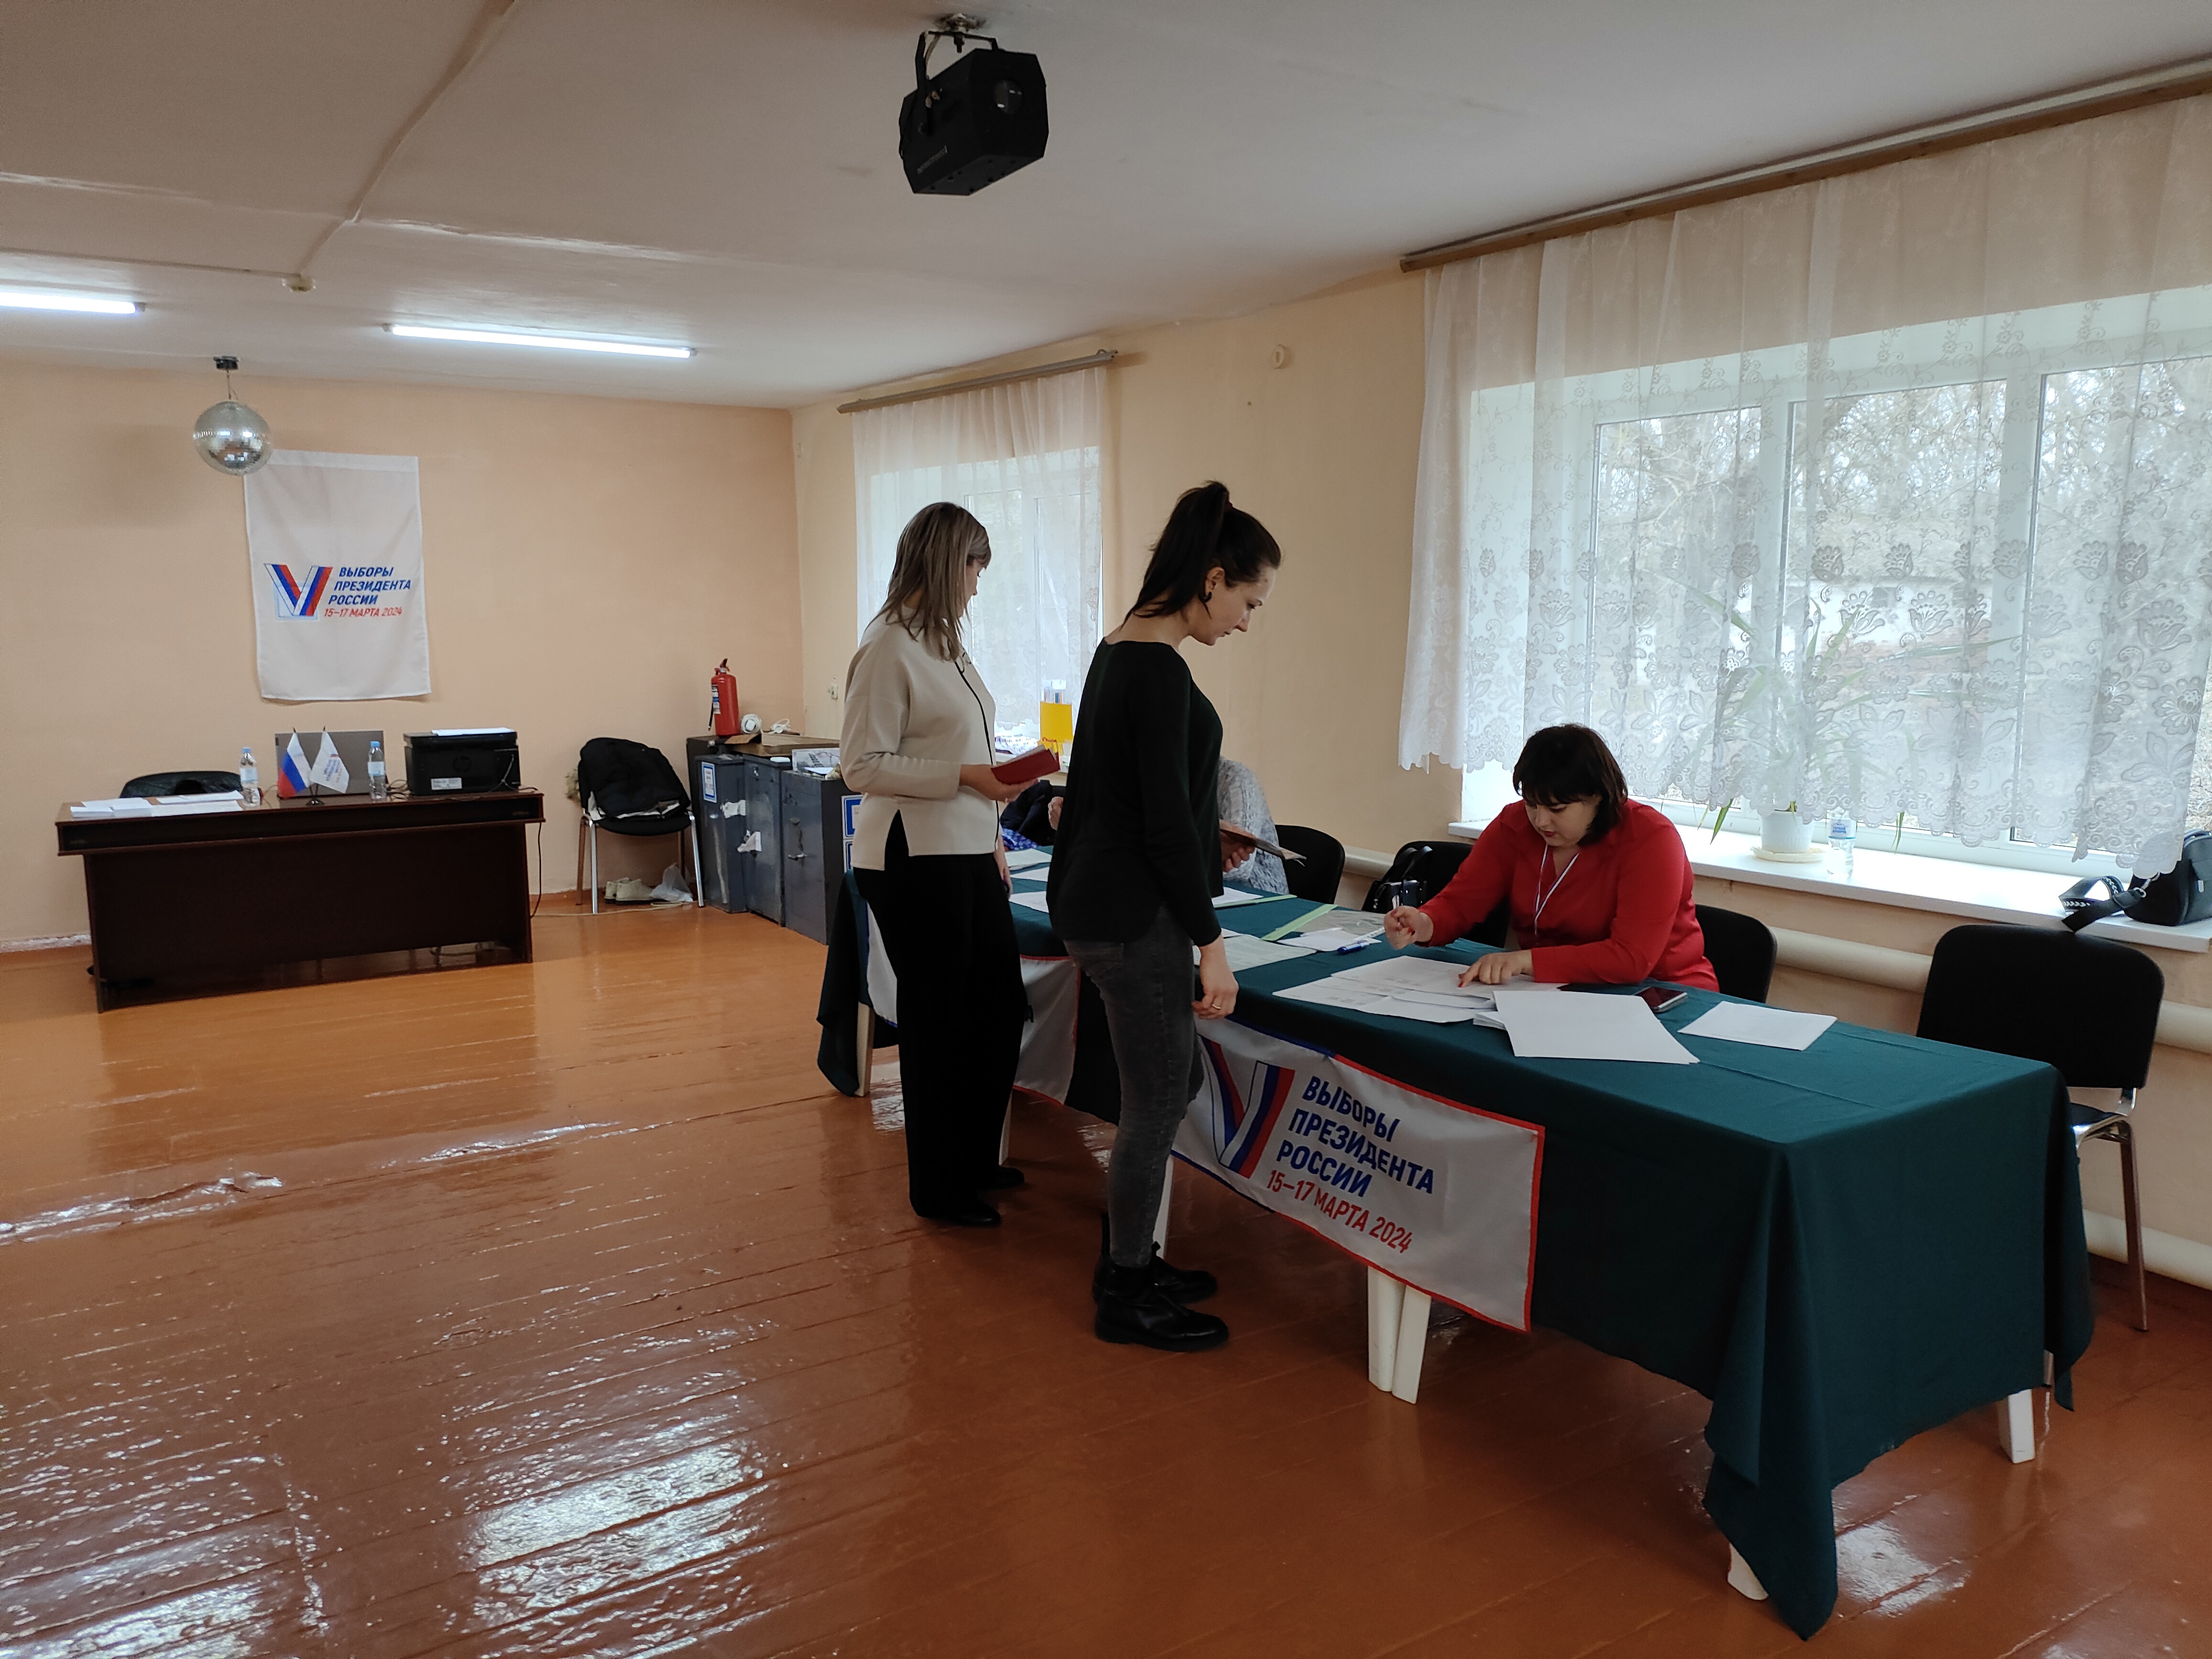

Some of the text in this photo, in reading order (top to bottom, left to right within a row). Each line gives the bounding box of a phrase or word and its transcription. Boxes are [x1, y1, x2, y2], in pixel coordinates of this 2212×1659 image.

[333, 579, 411, 592] ПРЕЗИДЕНТА
[339, 566, 394, 577] ВЫБОРЫ
[328, 595, 379, 605] РОССИИ
[349, 608, 380, 617] МАРТА
[381, 607, 403, 617] 2024
[1302, 1075, 1401, 1142] ВЫБОРЫ
[1276, 1139, 1372, 1197] РОССИИ
[1288, 1108, 1435, 1194] ПРЕЗИДЕНТА
[1314, 1187, 1370, 1232] МАРТА
[1369, 1216, 1413, 1253] 2024
